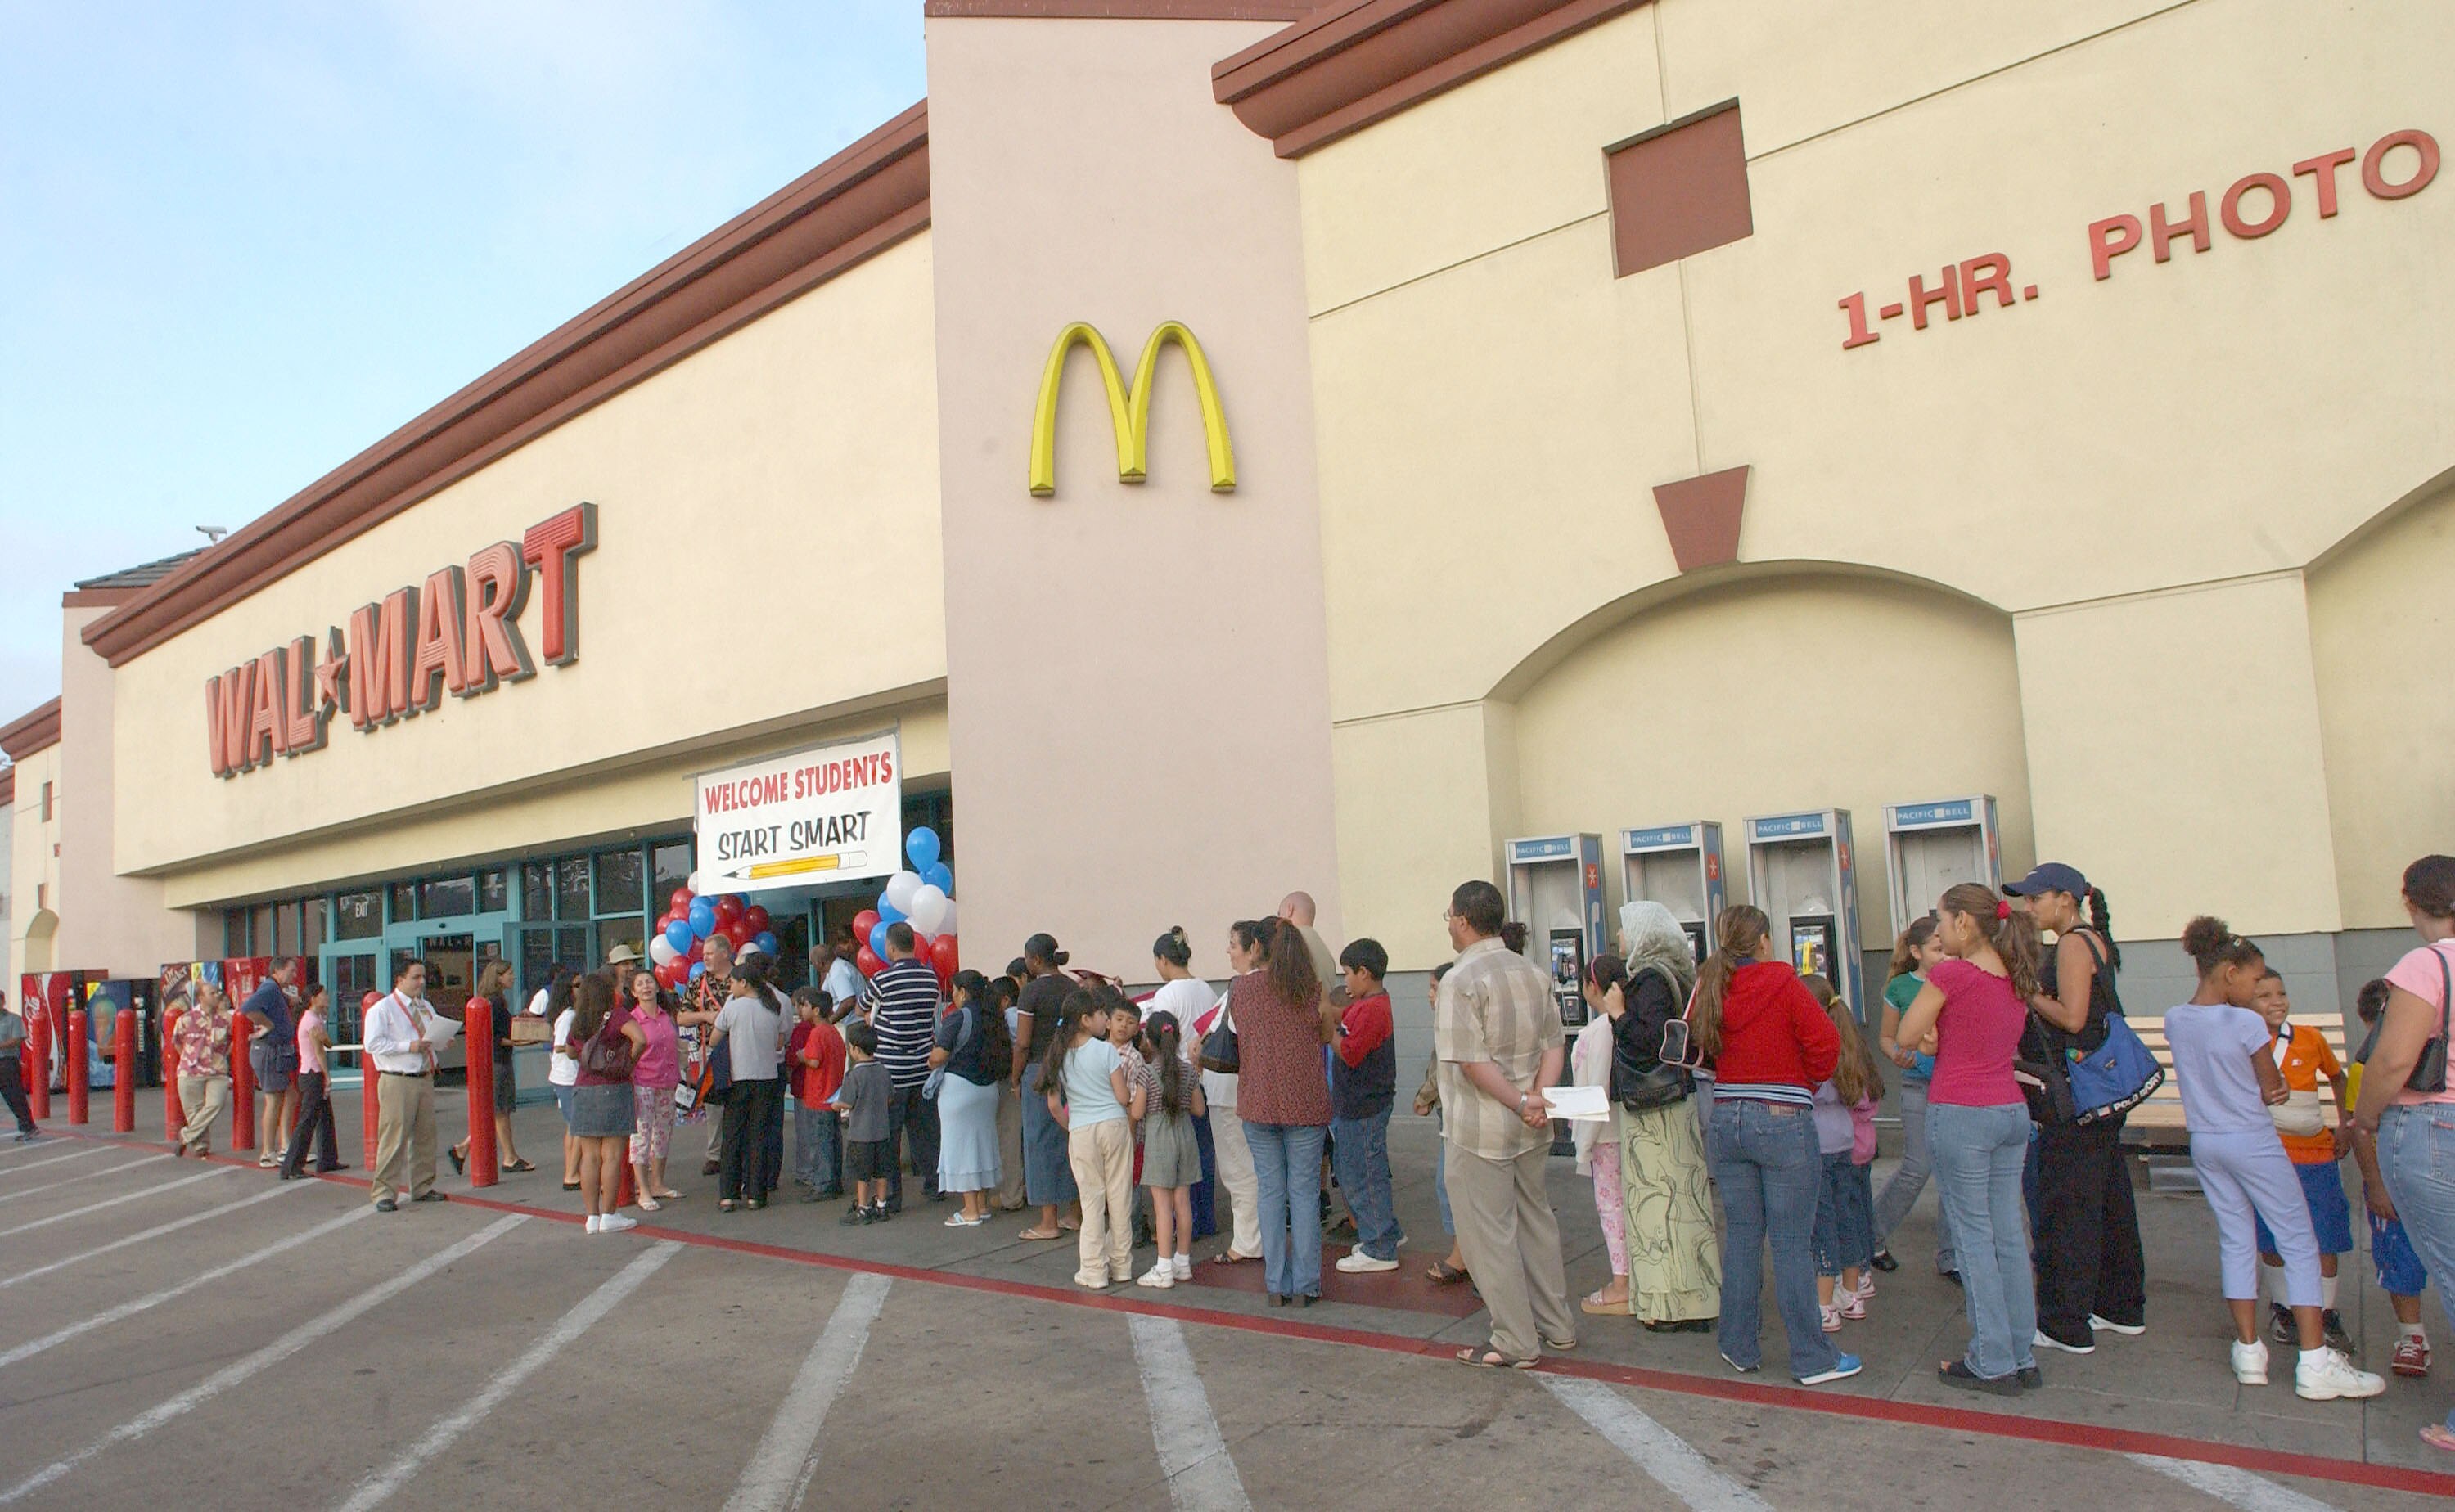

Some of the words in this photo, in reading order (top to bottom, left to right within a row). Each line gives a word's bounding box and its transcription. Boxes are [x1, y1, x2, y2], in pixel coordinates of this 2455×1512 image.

[1838, 251, 2039, 350] 1-HR.
[2088, 128, 2441, 281] PHOTO
[705, 772, 789, 814] WELCOME
[795, 751, 893, 800] STUDENTS
[1898, 808, 1934, 821] PACIFIC
[1945, 806, 1969, 817] BELL
[1757, 821, 1791, 833] PACIFIC
[1801, 819, 1822, 830] BELL
[718, 825, 782, 861] START
[791, 811, 872, 851] SMART
[1632, 832, 1663, 844] PACIFIC
[1672, 830, 1691, 841] BELL
[1516, 844, 1544, 855] PACIFIC
[1552, 842, 1571, 853] BELL
[355, 902, 368, 918] EXIT
